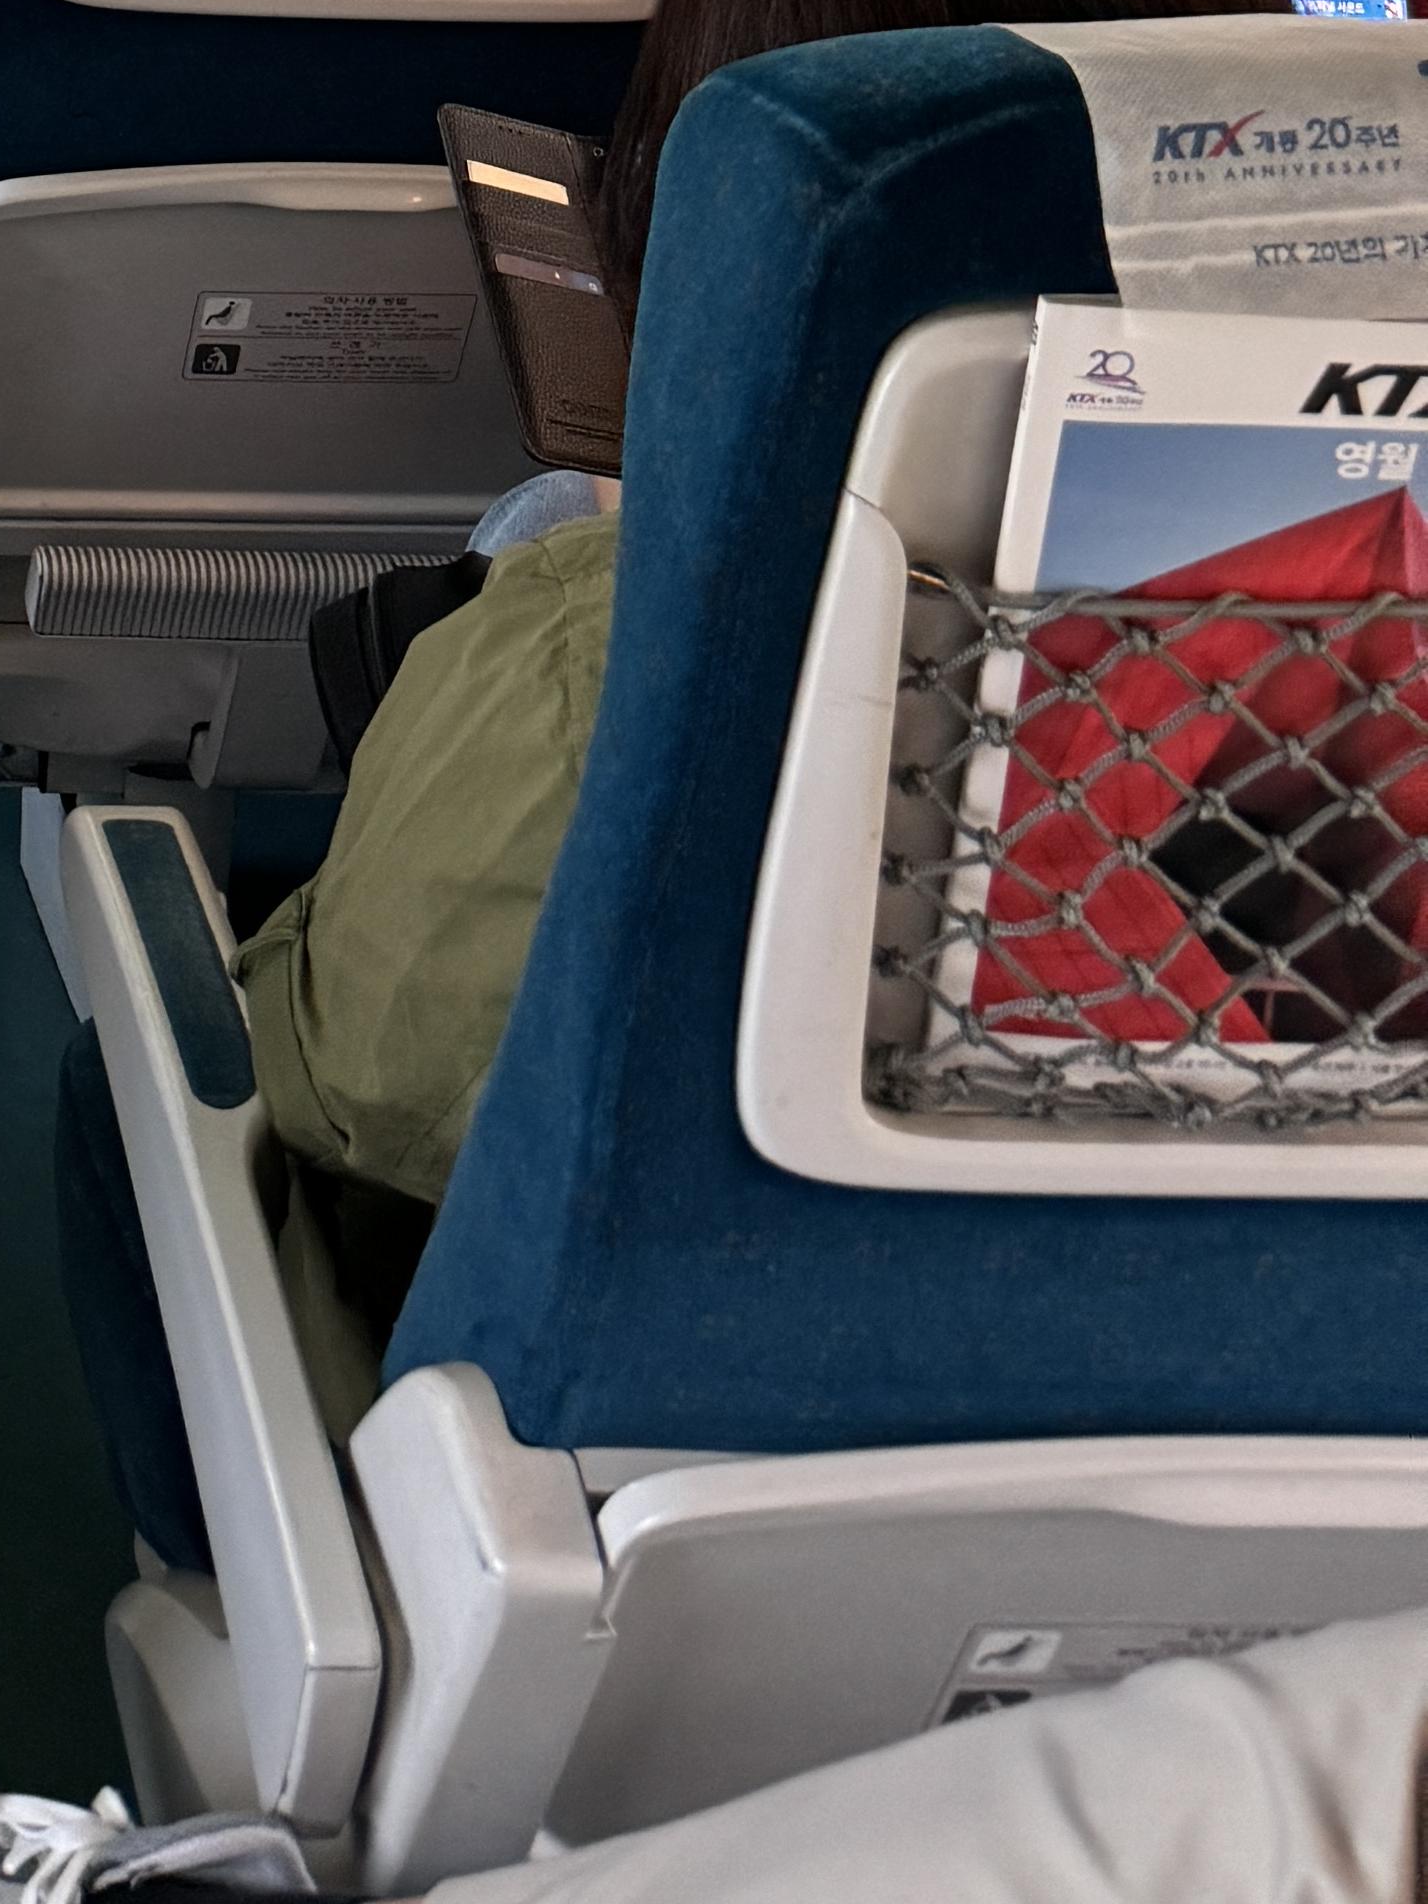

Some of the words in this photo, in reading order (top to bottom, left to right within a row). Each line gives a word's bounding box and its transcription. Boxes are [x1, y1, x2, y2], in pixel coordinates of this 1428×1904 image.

[1152, 109, 1266, 163] KTX
[1305, 116, 1401, 153] 20주년
[1253, 242, 1301, 268] KTX
[1305, 233, 1387, 266] 20년의
[1086, 348, 1136, 378] 20
[1334, 440, 1421, 482] 영월
